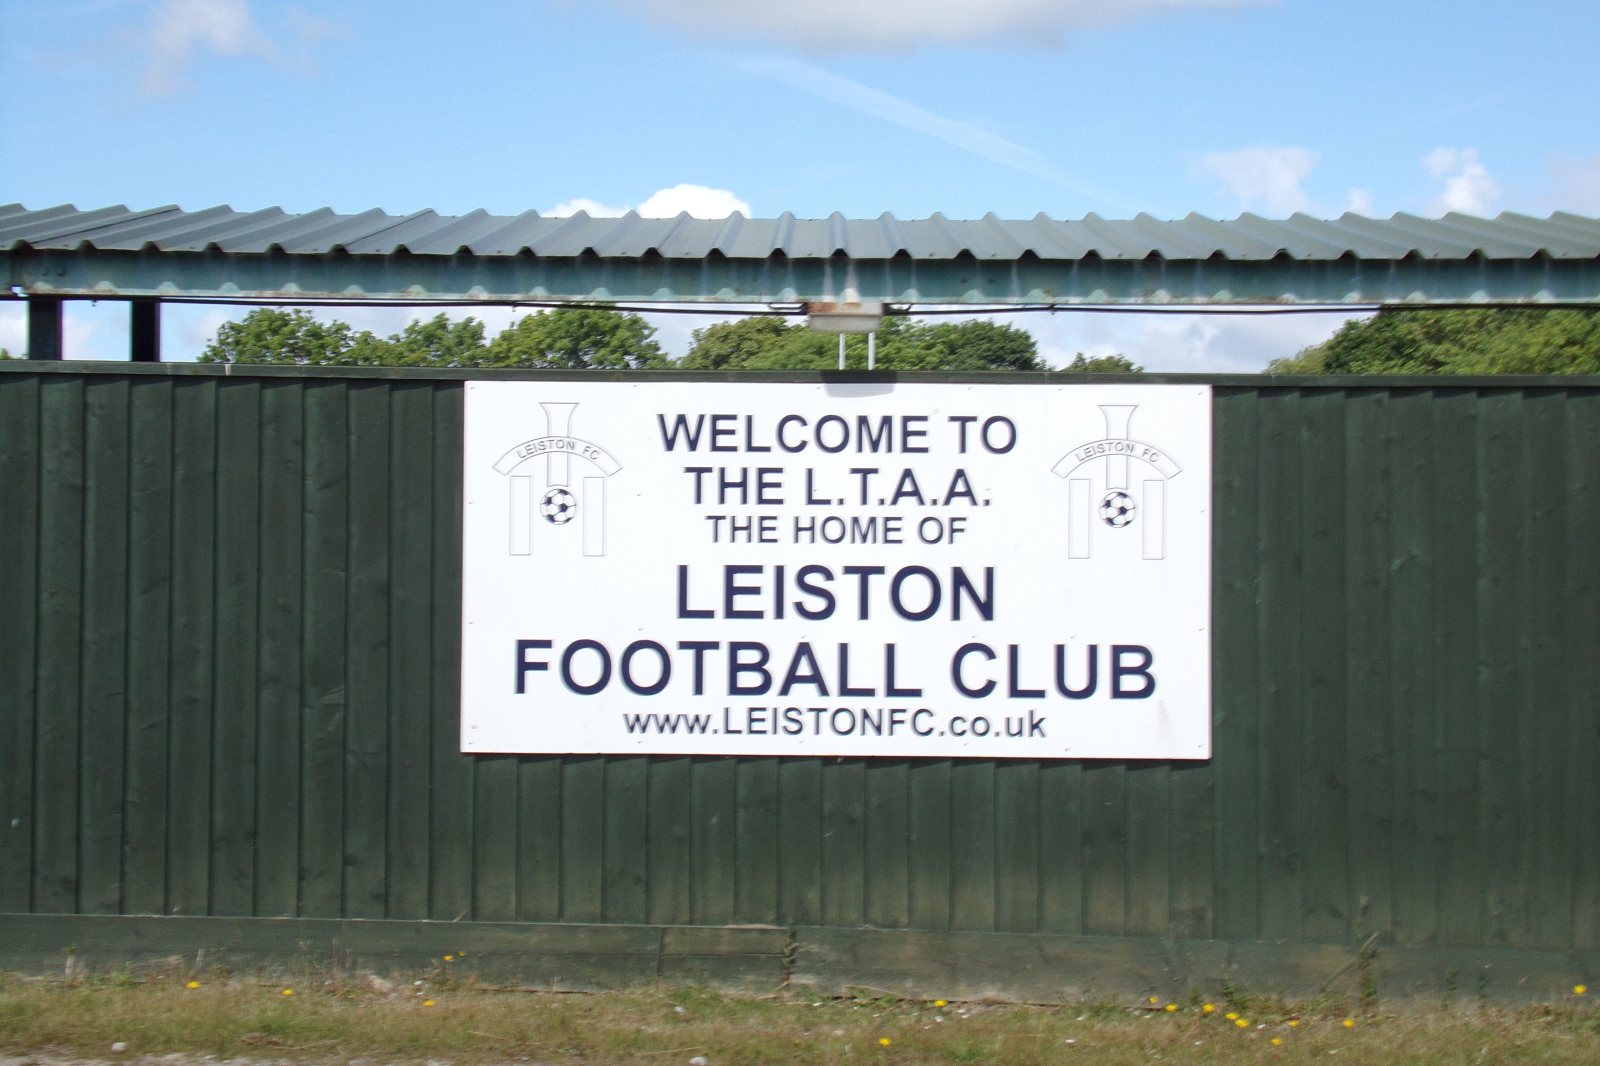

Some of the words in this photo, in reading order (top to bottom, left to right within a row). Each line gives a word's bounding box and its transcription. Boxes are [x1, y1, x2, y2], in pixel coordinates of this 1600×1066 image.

[515, 438, 575, 459] LEISTON
[582, 445, 601, 460] FC
[657, 413, 929, 455] WELCOME
[949, 414, 1018, 456] TO
[1074, 441, 1135, 462] LEISTON
[1141, 448, 1160, 463] FC
[683, 466, 785, 506] THE
[805, 467, 991, 507] L.T.A.A.
[705, 514, 779, 544] THE
[793, 515, 904, 545] HOME
[917, 516, 968, 545] OF
[677, 563, 995, 622] LEISTON
[514, 637, 924, 698] FOOTBALL
[950, 641, 1157, 701] CLUB
[623, 706, 1047, 738] www.LEISTONFC.co.uk
